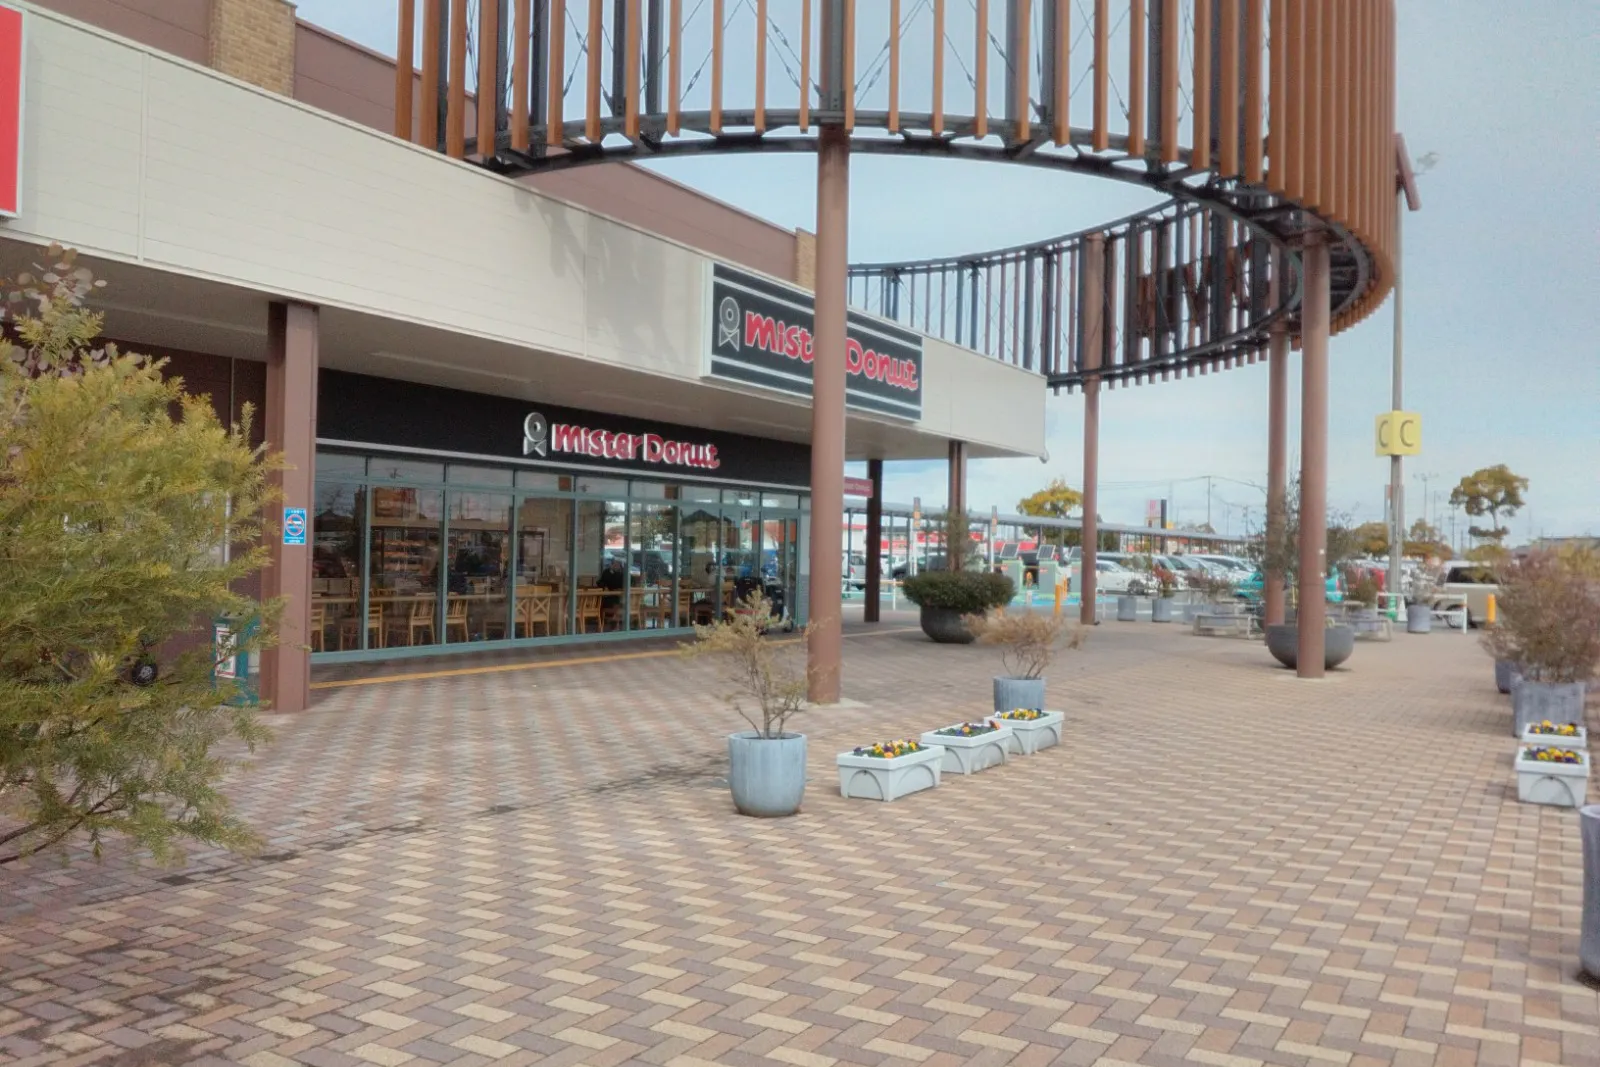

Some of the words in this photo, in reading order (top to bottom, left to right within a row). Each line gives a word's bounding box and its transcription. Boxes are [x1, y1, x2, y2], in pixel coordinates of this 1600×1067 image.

[845, 337, 918, 391] Donut
[1378, 419, 1389, 448] C
[1399, 419, 1414, 447] C
[643, 433, 720, 469] Donut
